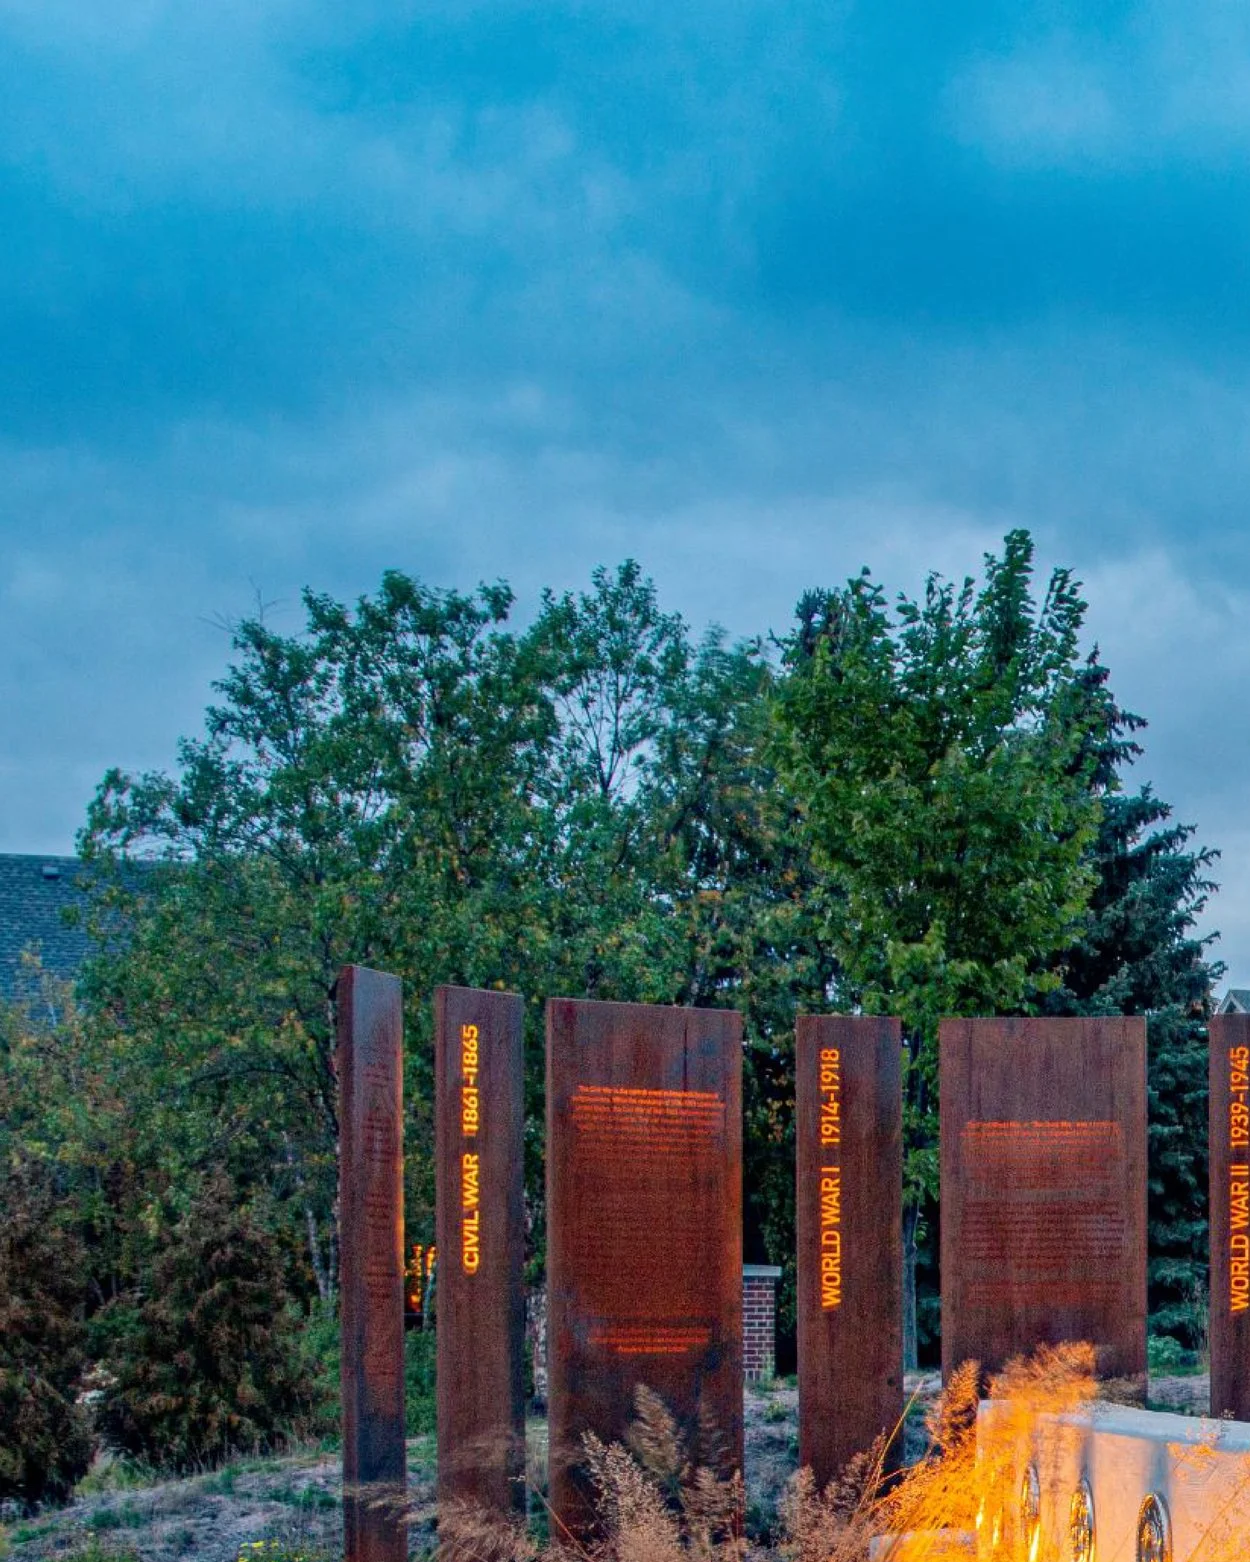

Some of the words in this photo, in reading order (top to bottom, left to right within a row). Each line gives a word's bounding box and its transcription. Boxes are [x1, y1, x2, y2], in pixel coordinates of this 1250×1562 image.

[462, 1023, 480, 1136] 1861-1865
[821, 1048, 841, 1145] 1914-1918
[1230, 1045, 1250, 1148] 1939-1945
[462, 1152, 480, 1209] WAR
[821, 1176, 841, 1227] WAR
[1230, 1164, 1250, 1177] II
[1230, 1181, 1250, 1230] WAR
[462, 1210, 480, 1273] CIVIL
[821, 1229, 841, 1310] WORLD
[1230, 1234, 1250, 1313] WORLD
